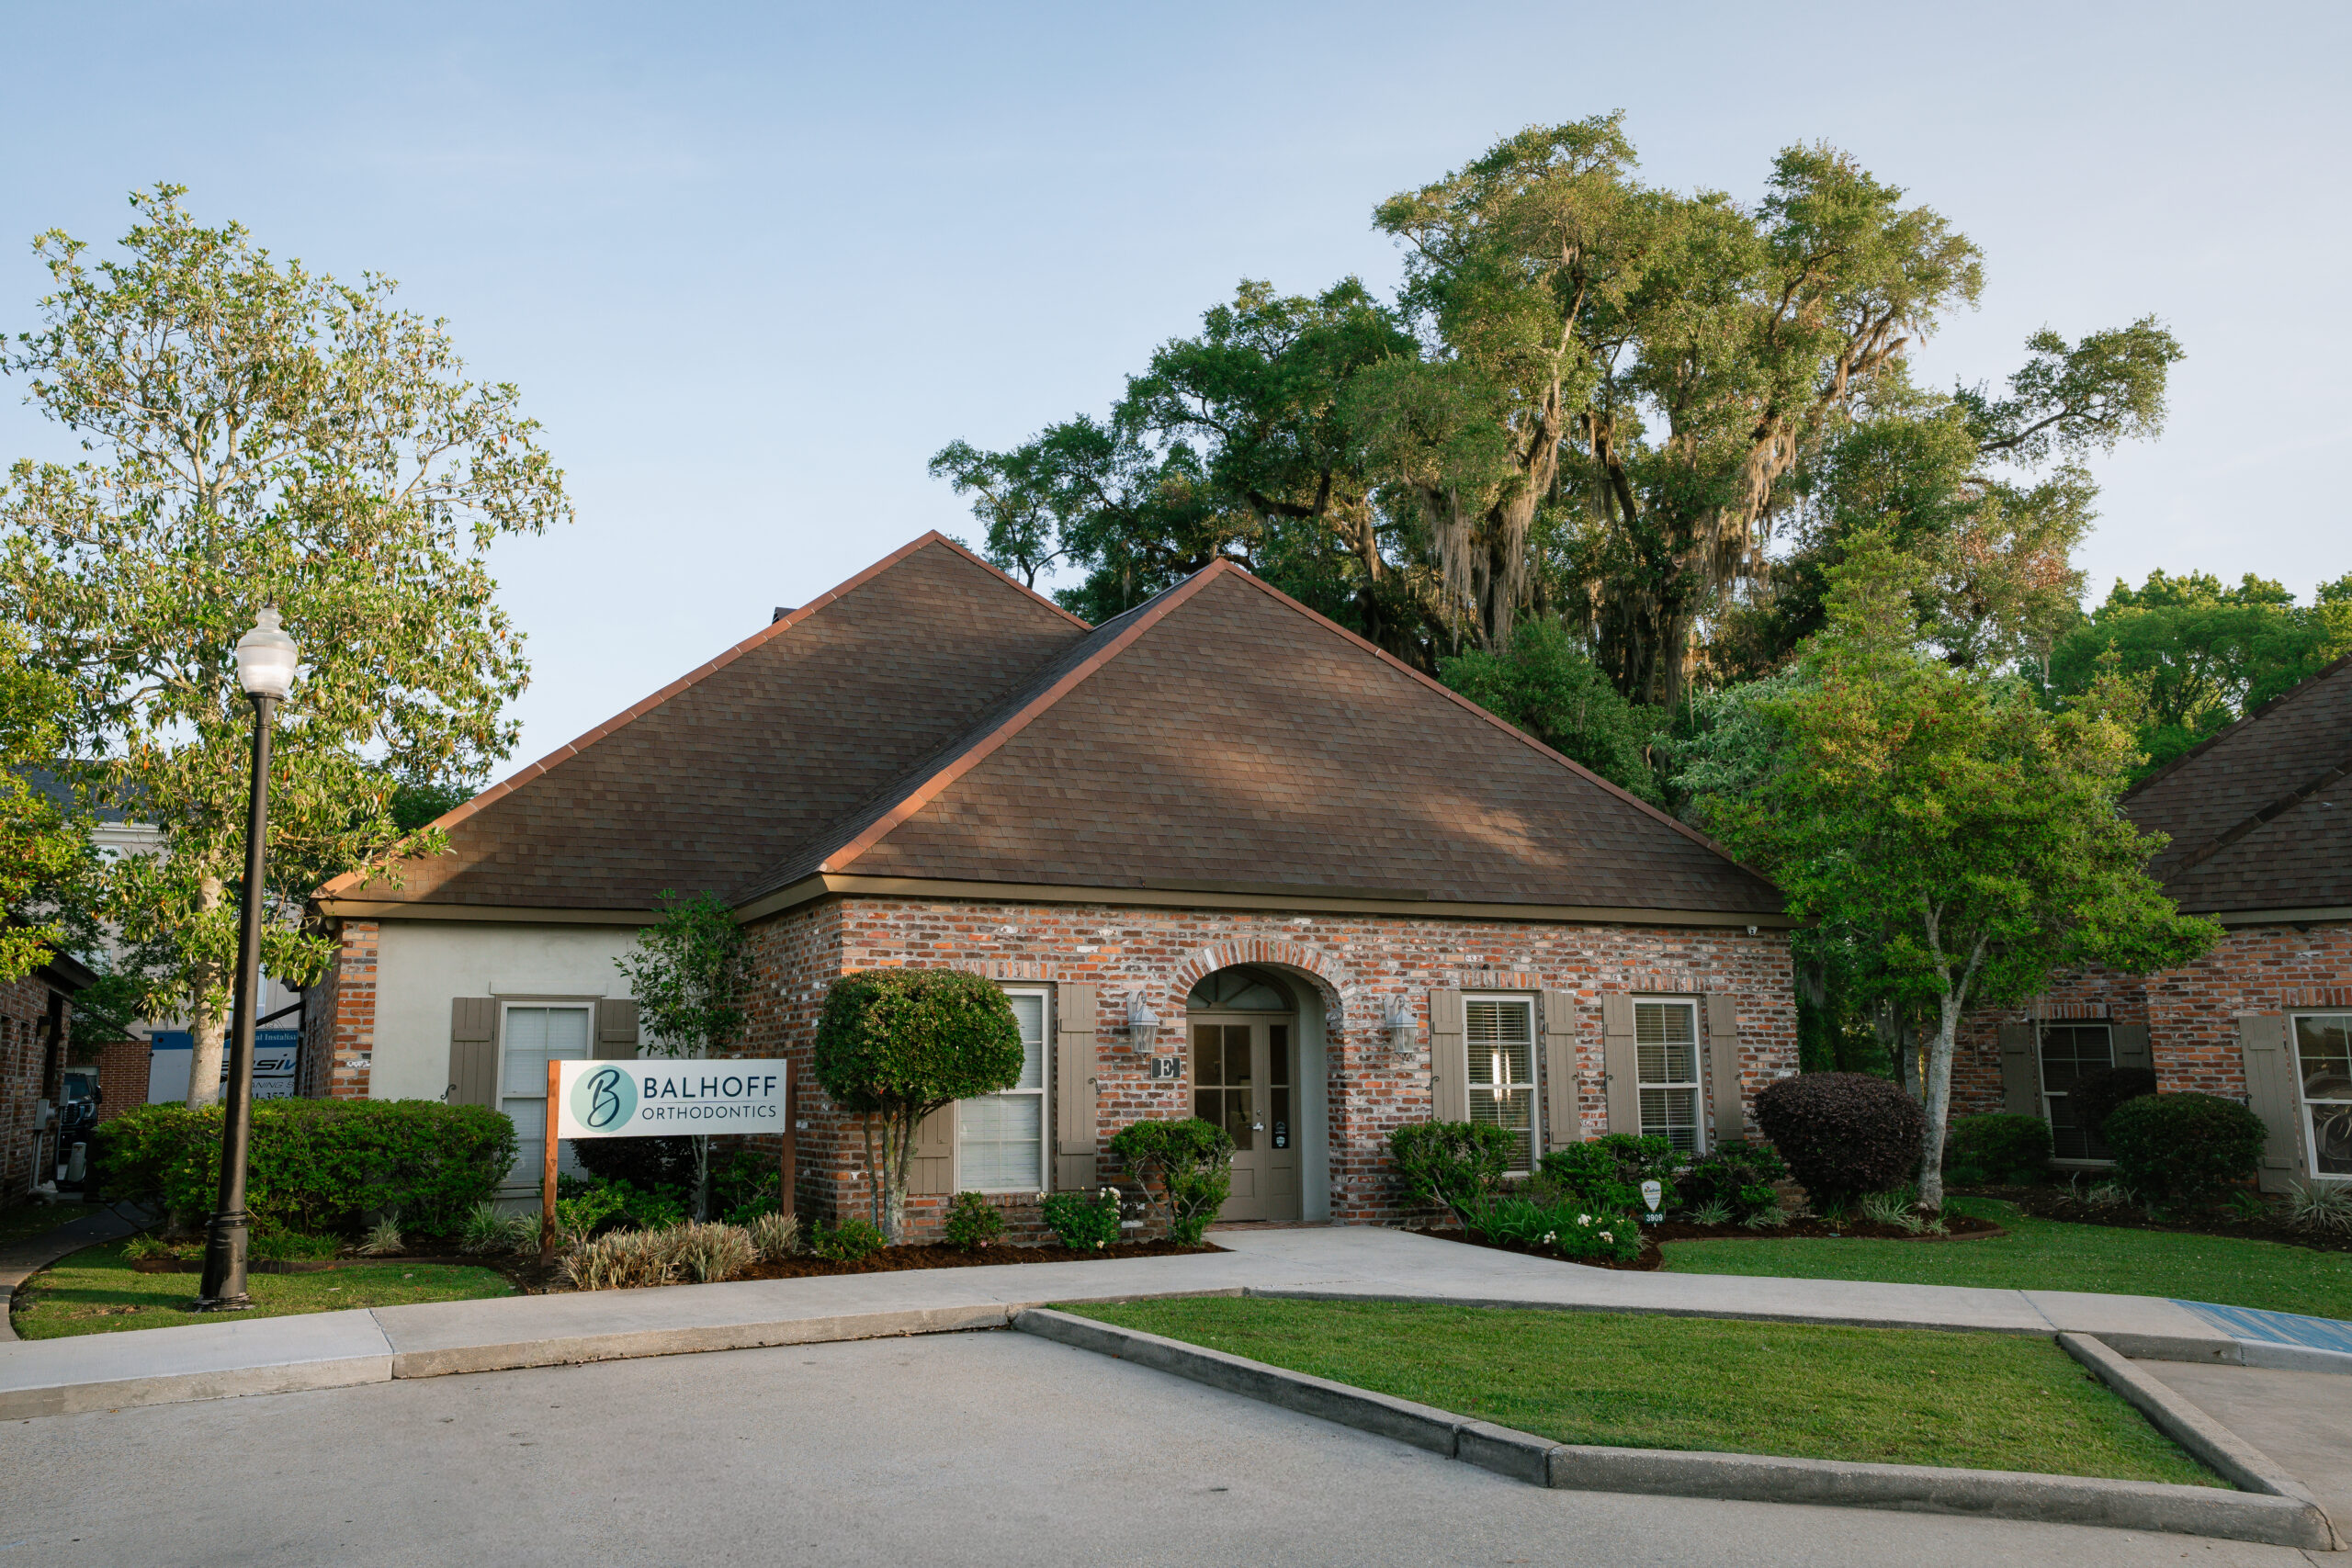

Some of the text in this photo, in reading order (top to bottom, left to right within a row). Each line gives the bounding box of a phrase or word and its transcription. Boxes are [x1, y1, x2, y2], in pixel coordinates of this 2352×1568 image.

[1159, 1058, 1173, 1077] E
[644, 1077, 777, 1099] BALHOFF
[587, 1069, 620, 1128] B
[642, 1105, 776, 1120] ORTHODONTICS
[1645, 1213, 1663, 1222] 3909
